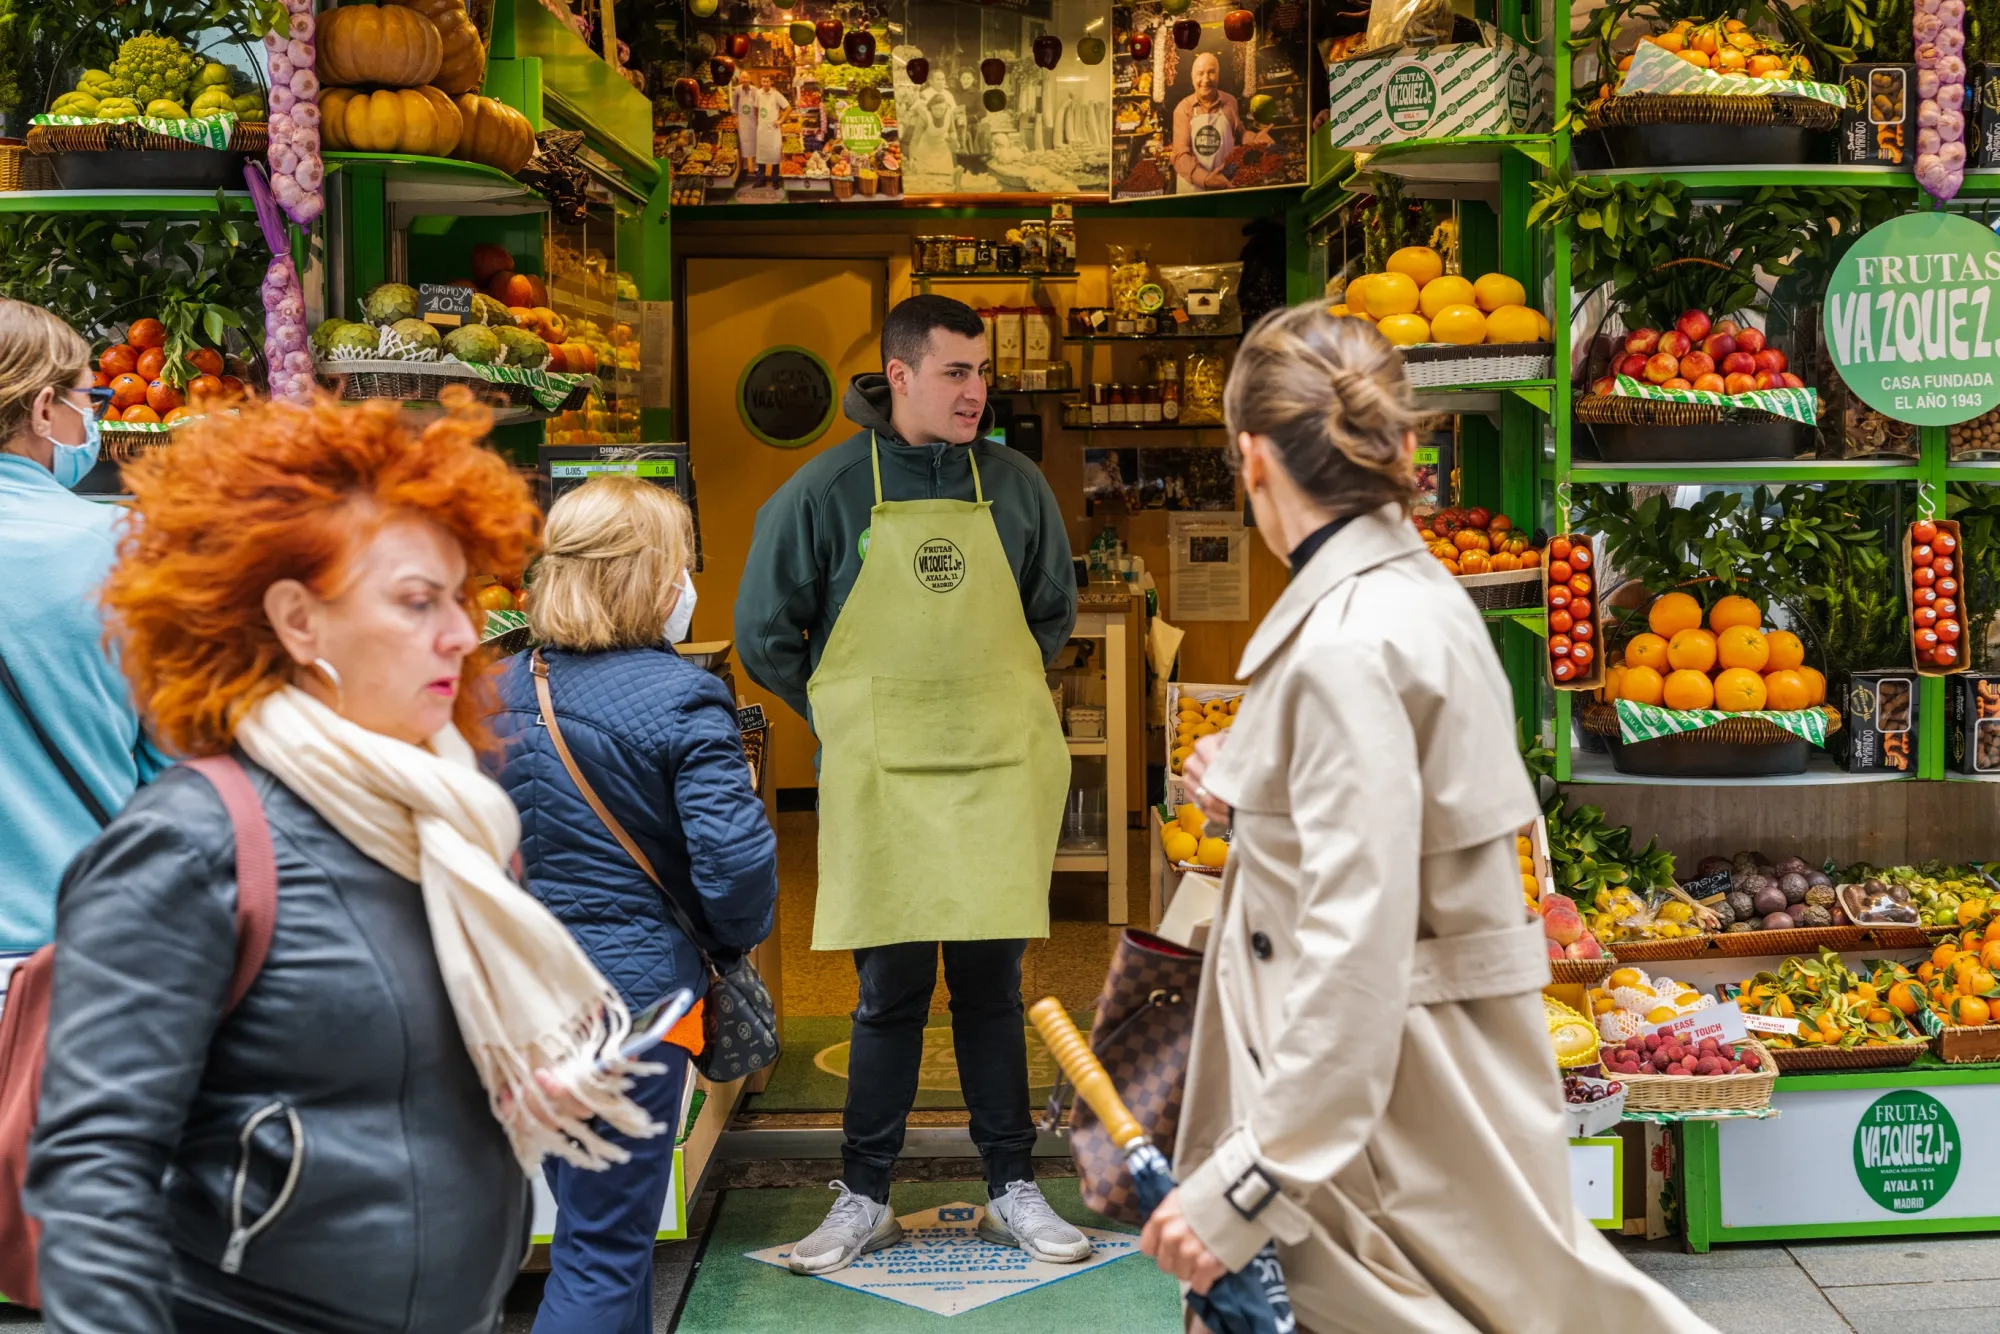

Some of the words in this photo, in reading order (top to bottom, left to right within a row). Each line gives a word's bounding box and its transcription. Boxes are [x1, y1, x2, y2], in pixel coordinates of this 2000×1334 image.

[1395, 71, 1425, 83] FRUTAS
[1389, 82, 1423, 107] VAZQUEZ
[1854, 121, 1866, 160] TAMARINDO
[1856, 251, 2000, 286] FRUTAS
[424, 296, 453, 311] 10
[1831, 285, 1991, 366] VAZQUEZ
[1881, 376, 1921, 391] CASA
[1924, 372, 1994, 389] FUNDADA
[1895, 397, 1913, 410] EL
[1916, 392, 1947, 409] AÑO
[1951, 394, 1982, 408] 1943
[600, 446, 623, 454] DIBAL
[919, 554, 953, 573] VAZQUEZ
[1621, 711, 1640, 733] AYALA,
[1862, 729, 1874, 767] TAMARINDO
[1689, 870, 1728, 891] PASION
[1694, 1022, 1723, 1038] TOUCH
[1875, 1103, 1938, 1122] FRUTAS
[1861, 1123, 1933, 1168] VAZQUEZ
[1884, 1179, 1918, 1192] AYALA
[1922, 1179, 1934, 1191] 11
[1894, 1197, 1925, 1209] MADRID
[849, 1258, 998, 1269] ASTRONÓMICA
